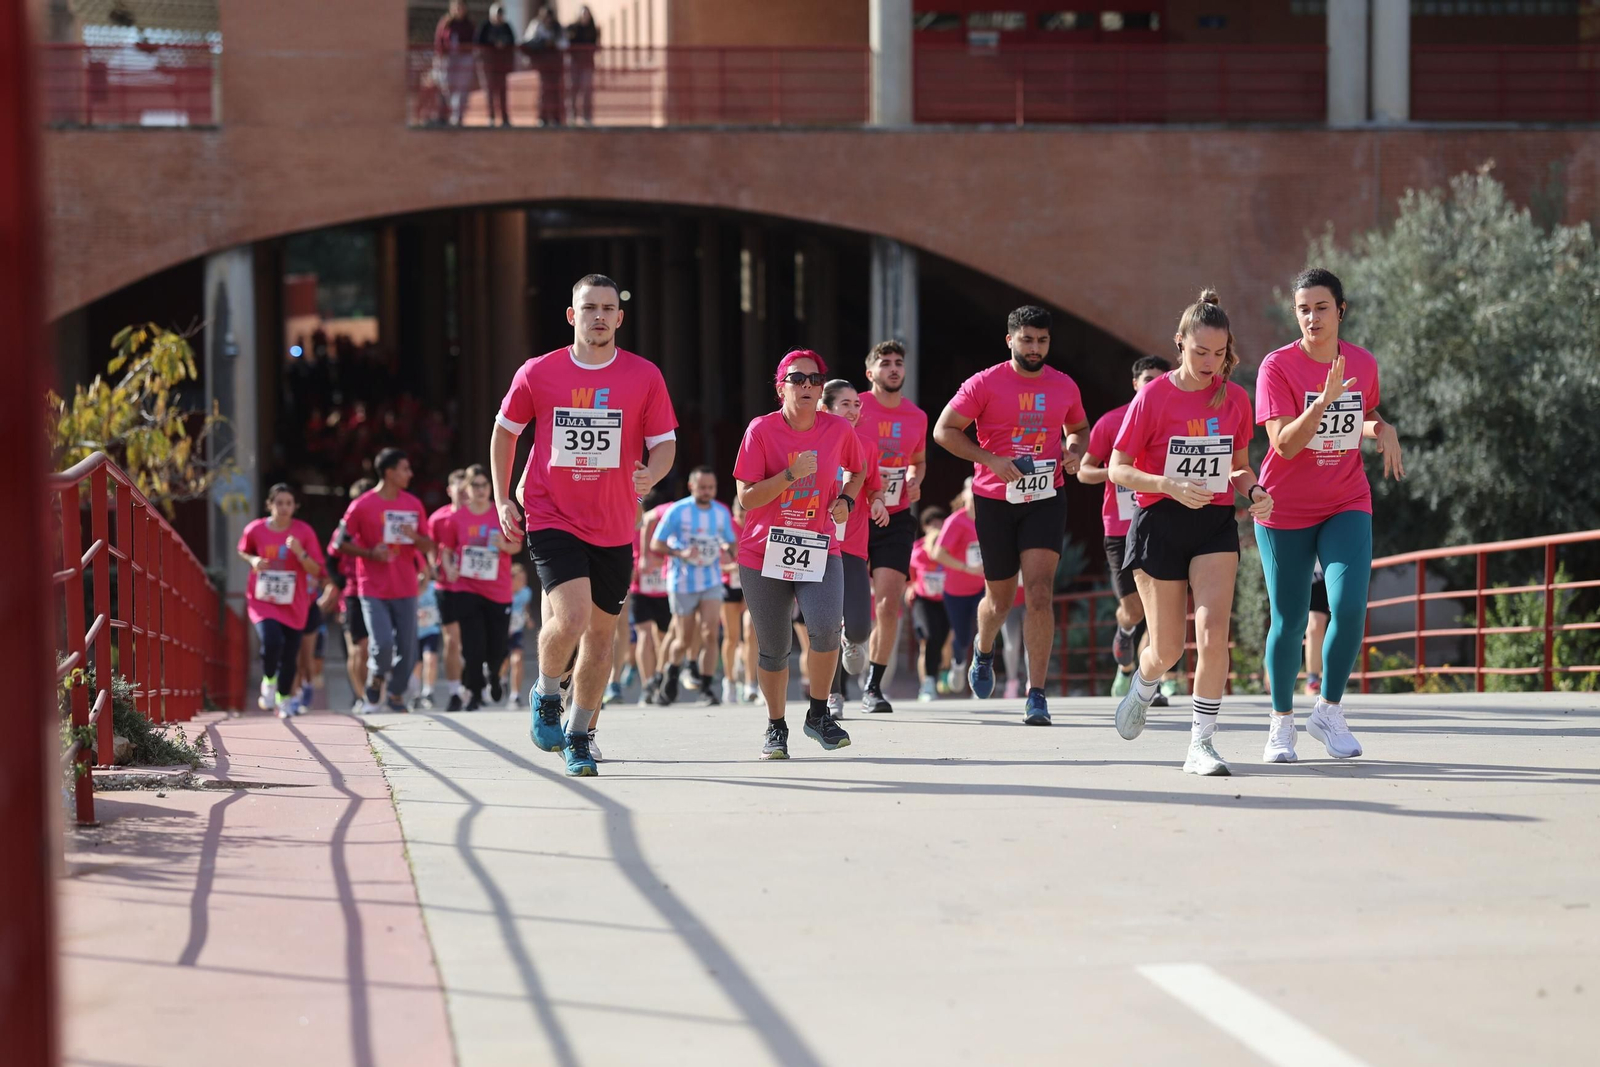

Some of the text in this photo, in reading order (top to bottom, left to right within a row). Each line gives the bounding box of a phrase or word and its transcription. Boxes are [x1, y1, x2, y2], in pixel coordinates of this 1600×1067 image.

[571, 387, 610, 409] WE
[1018, 392, 1046, 411] WE
[557, 417, 587, 427] UMA
[878, 421, 902, 438] WE
[1187, 417, 1220, 437] WE
[1316, 413, 1355, 434] 518
[564, 429, 610, 451] 395
[1172, 445, 1201, 455] UMA
[1176, 457, 1221, 477] 441
[1016, 475, 1048, 493] 440
[771, 533, 798, 545] UMA
[782, 546, 810, 568] 84
